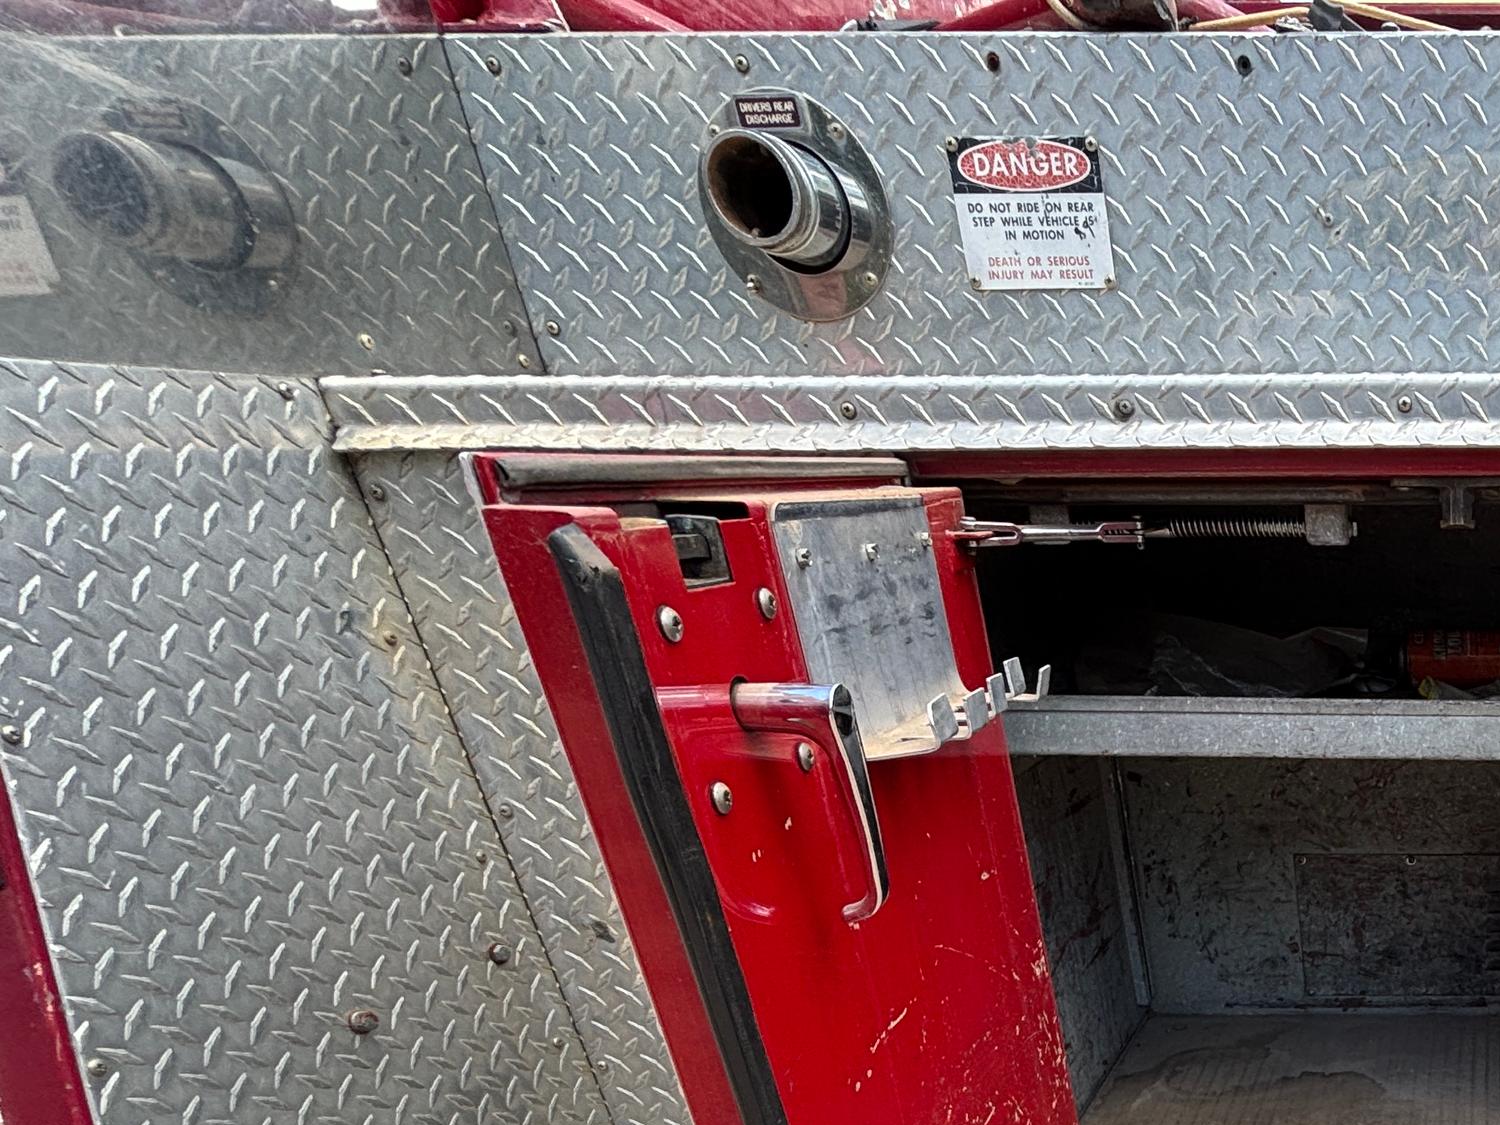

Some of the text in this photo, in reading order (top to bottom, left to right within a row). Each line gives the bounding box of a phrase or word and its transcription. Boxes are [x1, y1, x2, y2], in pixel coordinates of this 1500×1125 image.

[739, 100, 795, 113] DRIVERS REAR
[745, 113, 795, 124] DISCHARGE
[972, 151, 1080, 177] DANGER
[967, 201, 1095, 214] DO NOT RIDE ON REAR
[972, 216, 996, 228] STEP
[1001, 216, 1033, 227] WHILE
[1038, 215, 1080, 227] VEHICLE
[1004, 229, 1065, 241] IN MOTION
[988, 255, 1090, 267] DEATH OR SERIOUS
[988, 269, 1094, 281] INJURY MAY RESULT
